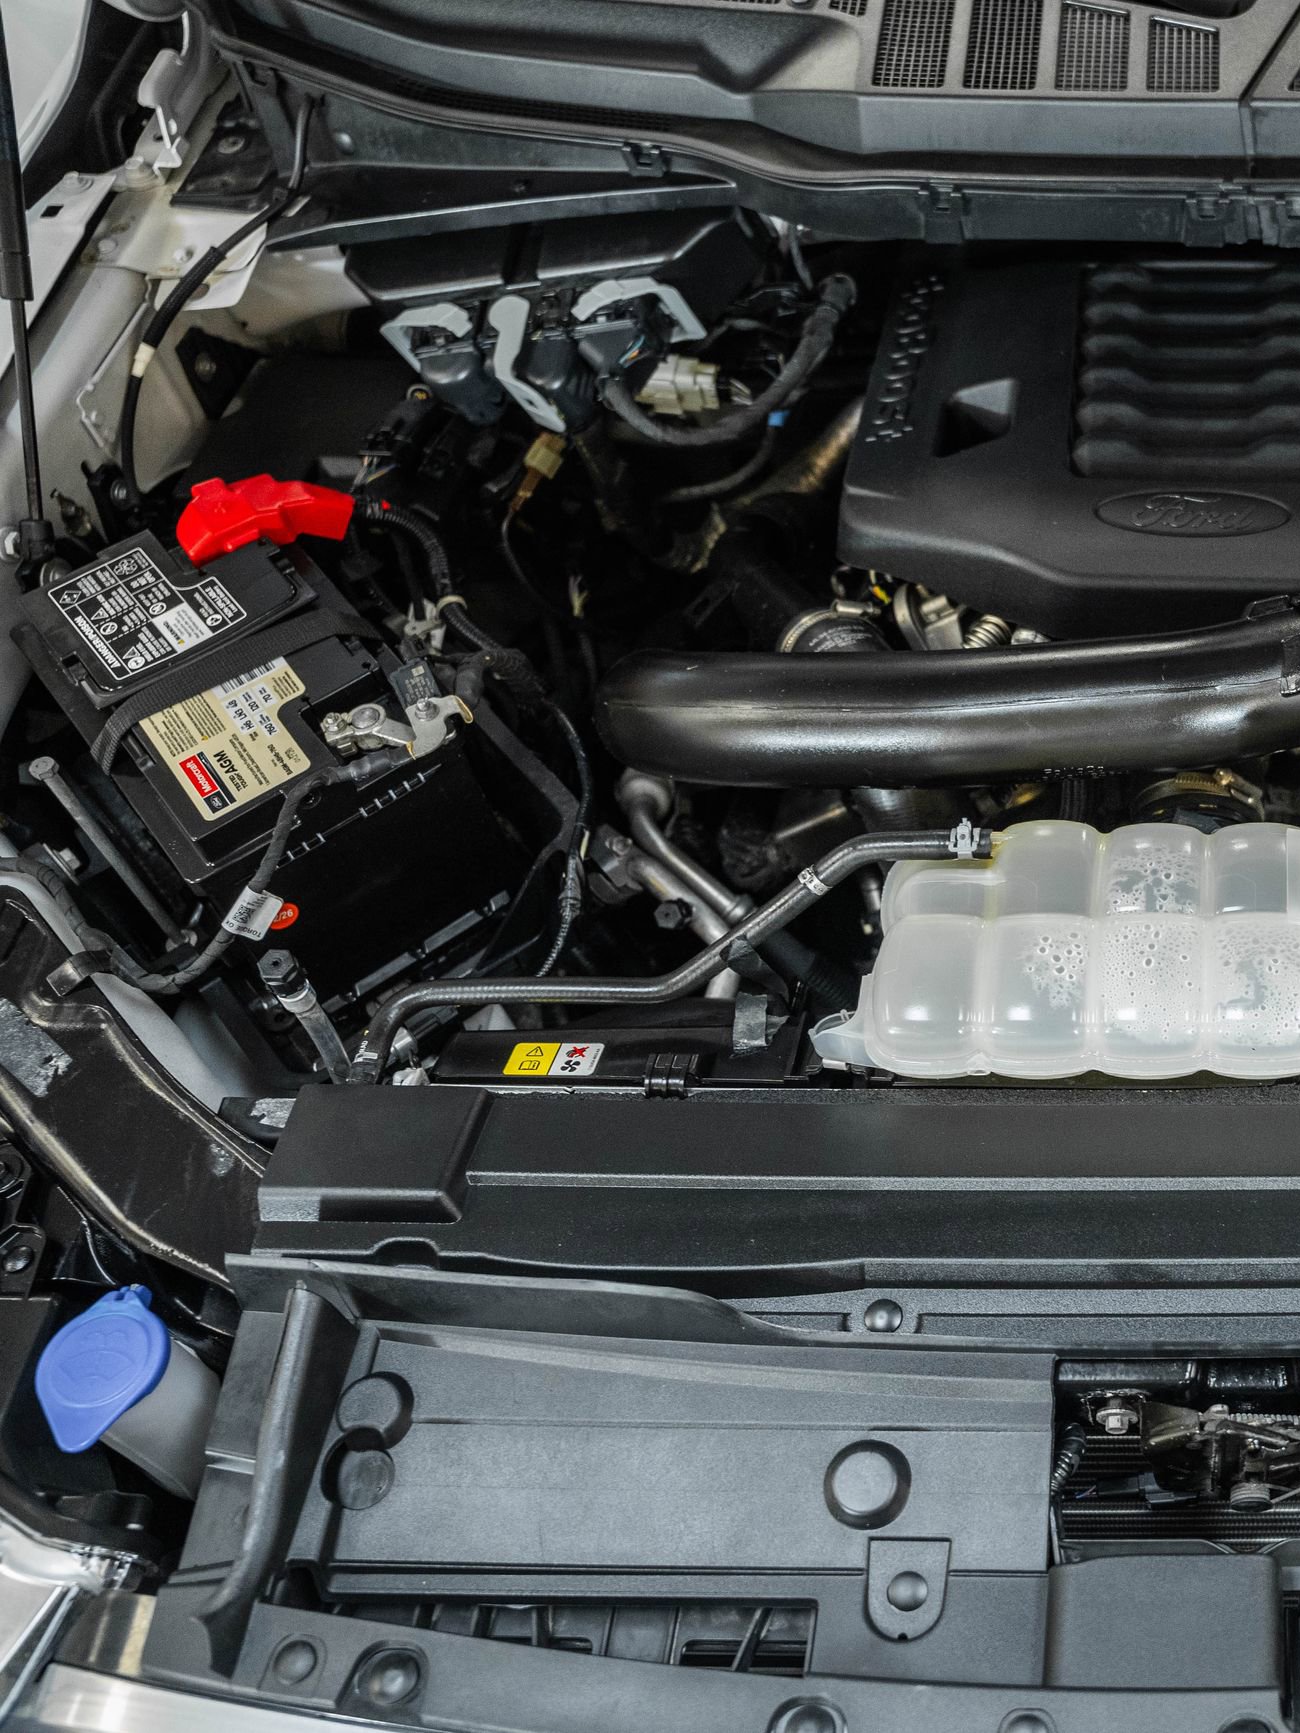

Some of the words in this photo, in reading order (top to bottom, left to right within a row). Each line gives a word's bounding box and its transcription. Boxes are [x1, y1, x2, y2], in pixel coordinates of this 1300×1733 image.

[1131, 494, 1255, 529] Ford
[74, 615, 117, 665] DANGER/POISON
[248, 700, 260, 712] 120
[262, 694, 274, 704] 70
[234, 707, 248, 721] LN3
[243, 719, 255, 730] H6
[264, 722, 278, 736] 760
[212, 749, 238, 777] AGM
[185, 759, 213, 793] Motorcraft
[228, 774, 243, 792] TESTED
